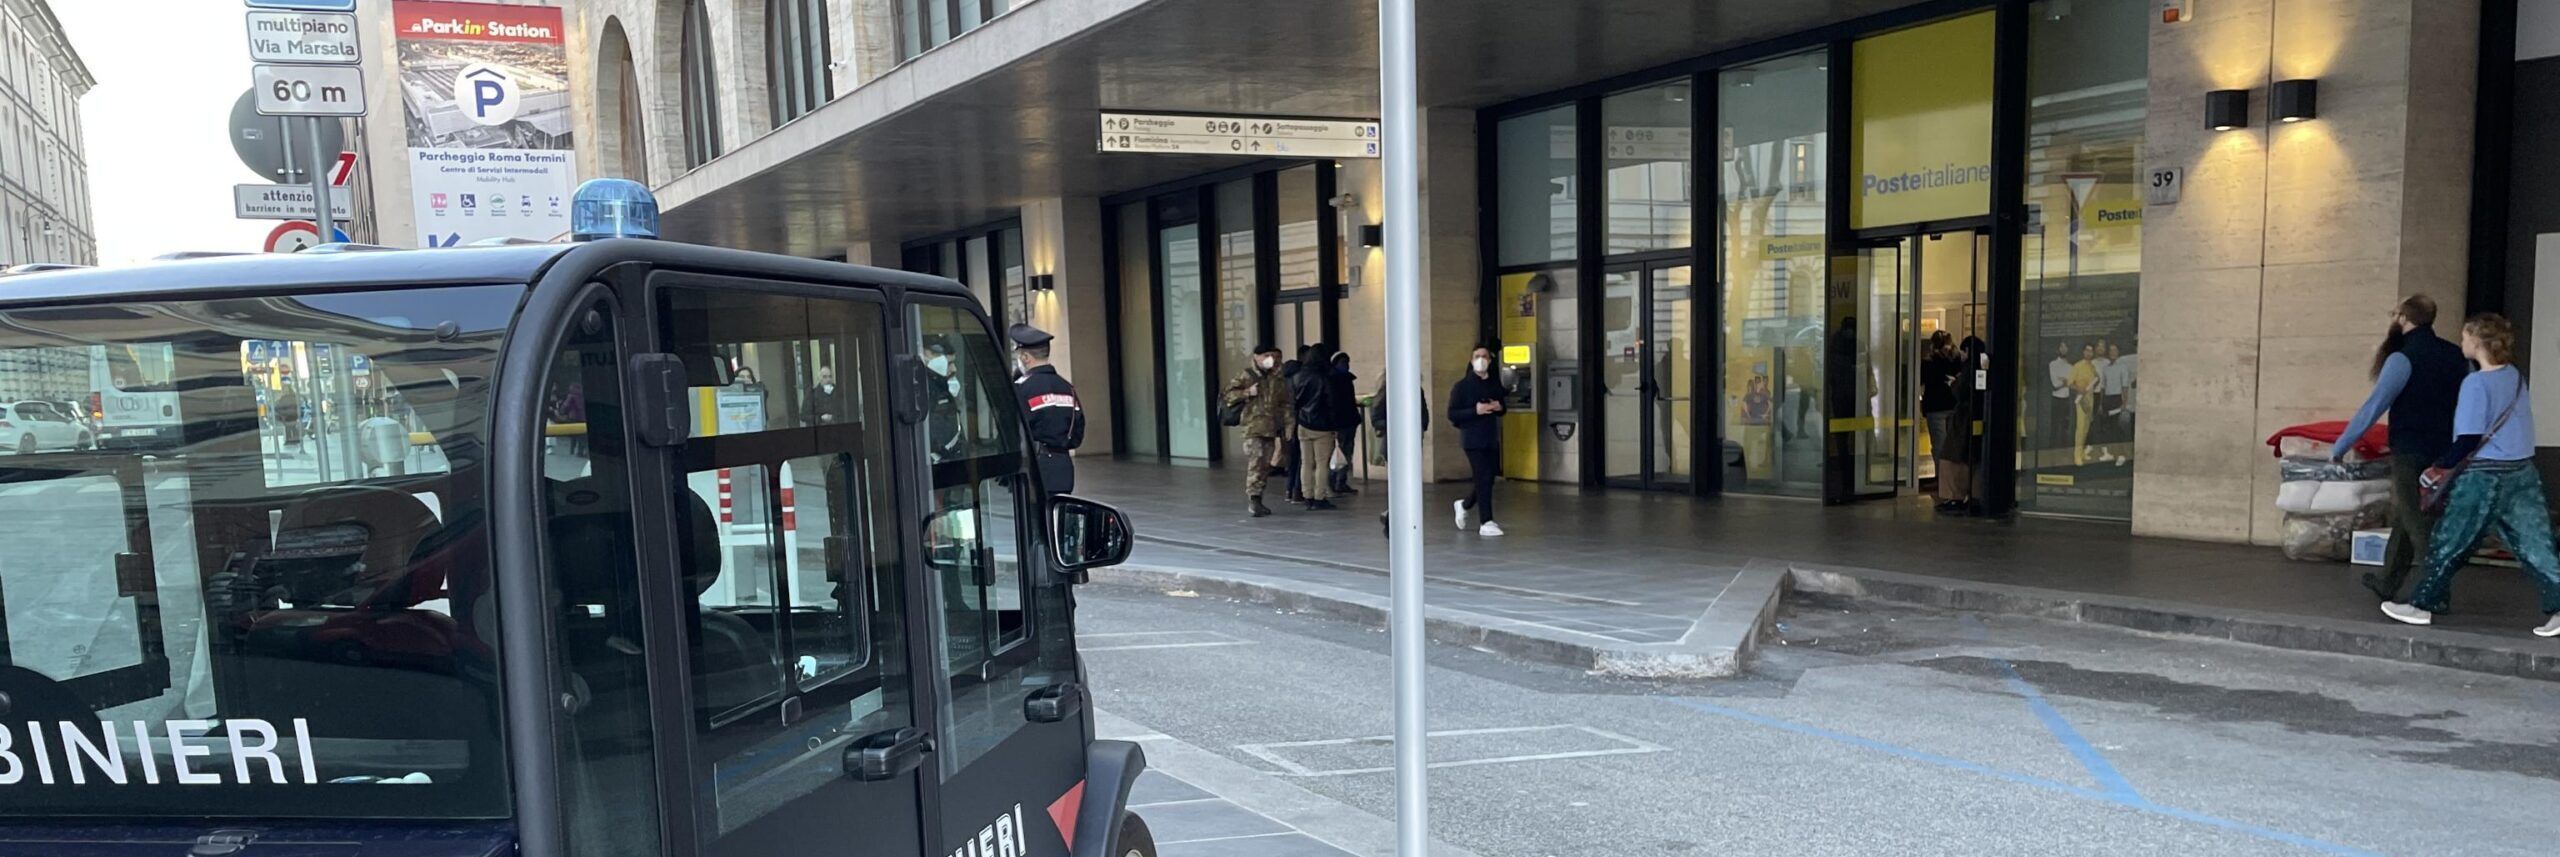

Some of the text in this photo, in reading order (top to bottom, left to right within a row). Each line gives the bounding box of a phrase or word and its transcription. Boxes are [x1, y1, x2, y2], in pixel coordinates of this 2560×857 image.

[257, 18, 348, 35] multipiano
[488, 21, 550, 38] Station
[254, 39, 356, 55] Via Marsala
[273, 79, 346, 102] 60 m
[419, 152, 566, 163] Parcheggio Roma Termini
[477, 166, 503, 174] Servizi
[1863, 163, 1990, 196] Posteitaliane
[2153, 171, 2174, 187] 39
[263, 190, 313, 201] attenzio
[246, 205, 281, 213] barriere
[286, 205, 295, 213] in
